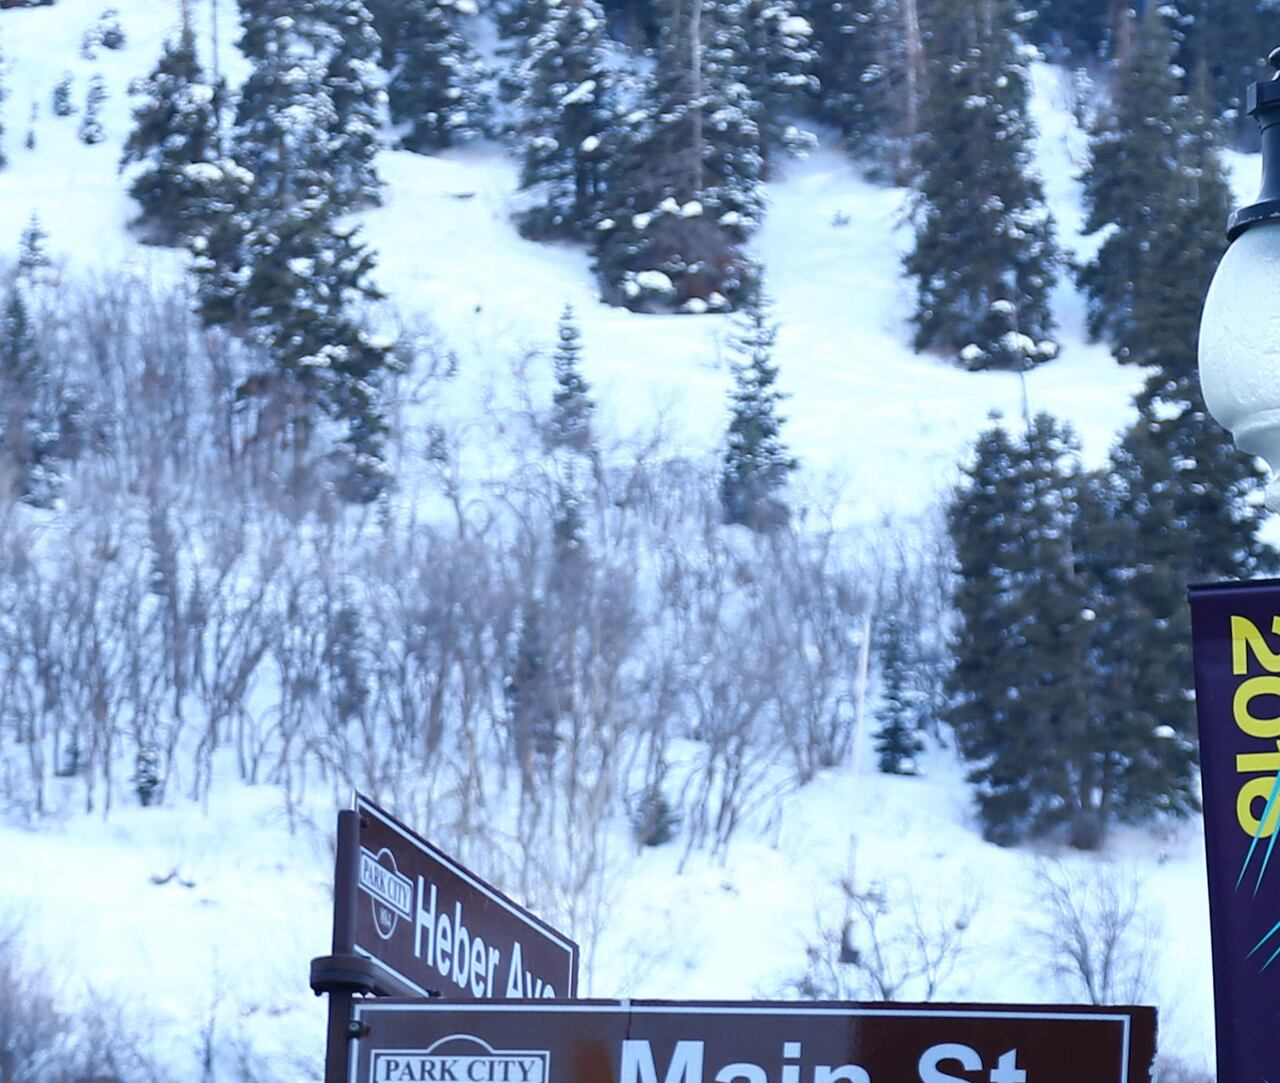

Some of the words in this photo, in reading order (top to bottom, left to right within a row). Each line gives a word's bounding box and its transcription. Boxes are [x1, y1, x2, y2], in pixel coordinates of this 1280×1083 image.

[363, 857, 386, 894] PARK
[387, 876, 410, 909] CITY
[414, 874, 500, 998] Heber
[384, 1059, 459, 1082] PARK
[467, 1059, 536, 1083] CITY
